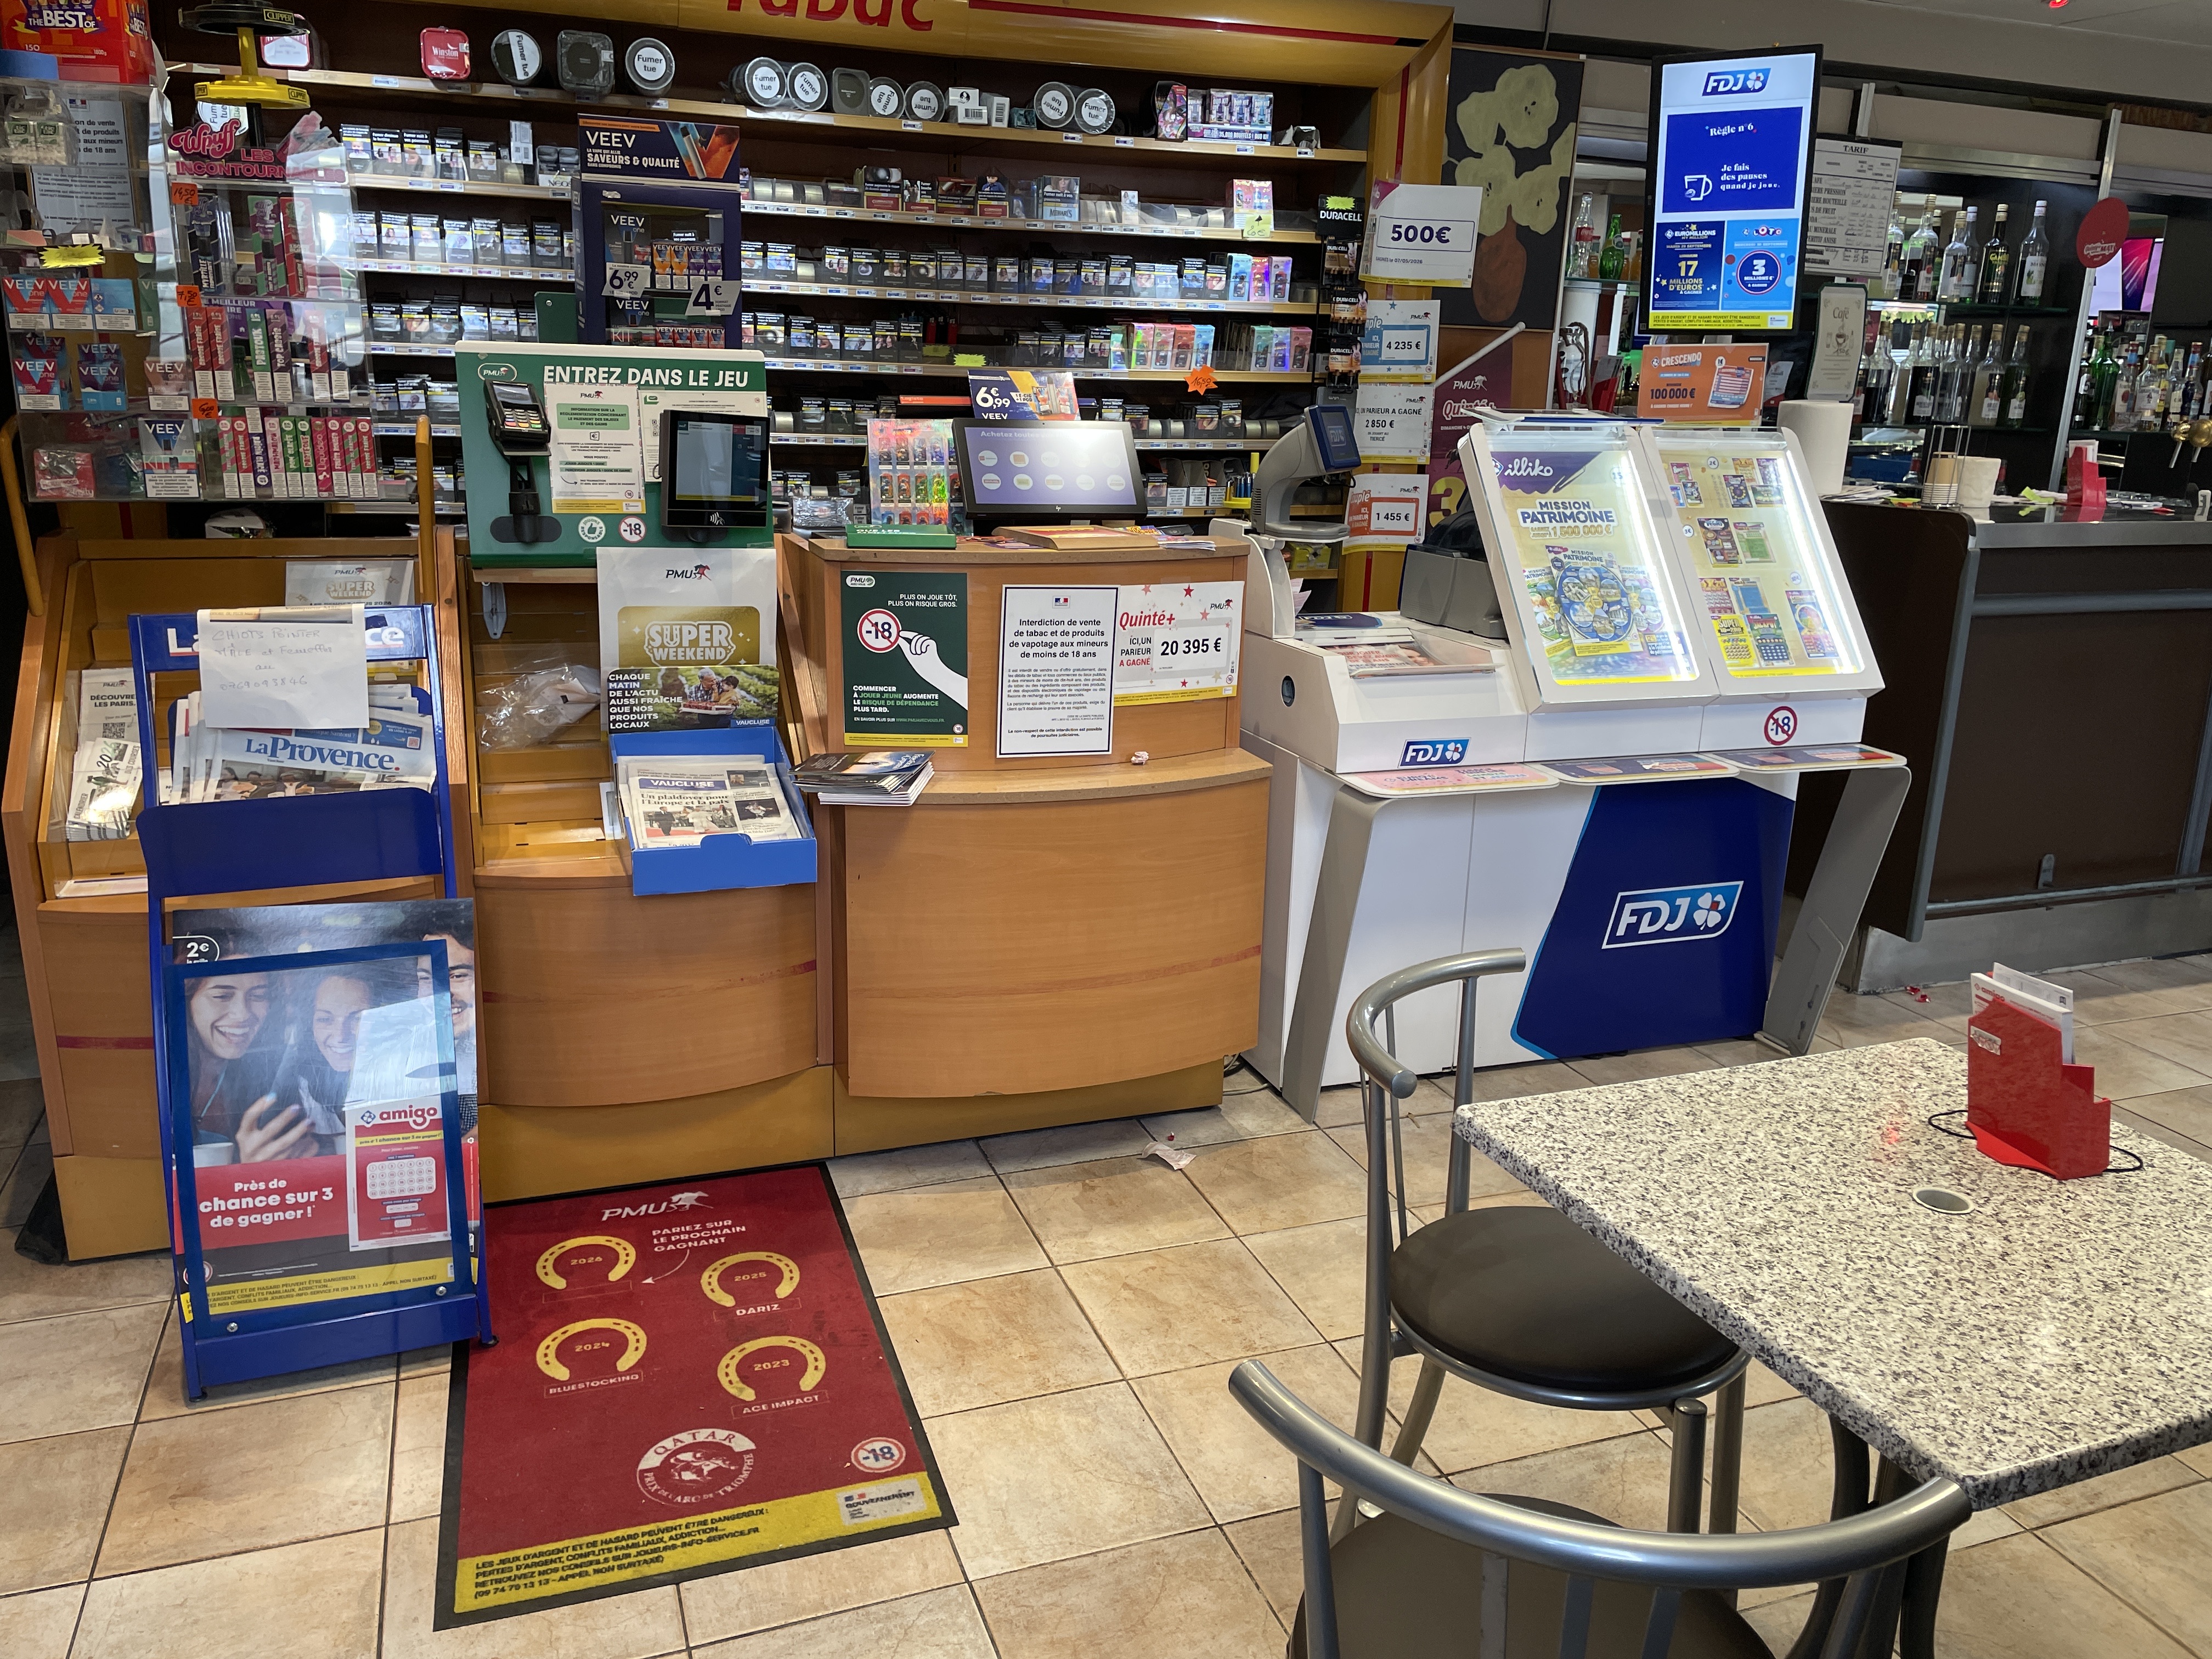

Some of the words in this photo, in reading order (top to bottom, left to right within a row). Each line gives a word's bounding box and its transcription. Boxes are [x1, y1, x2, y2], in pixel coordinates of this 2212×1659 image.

[42, 10, 86, 27] BEST
[267, 13, 292, 22] CLIPPER
[432, 45, 459, 57] Winston
[637, 55, 663, 64] Fumer
[1706, 74, 1745, 92] FDJ
[1085, 103, 1106, 111] Fumer
[1710, 125, 1736, 137] Règle
[586, 131, 636, 148] VEEV
[1843, 145, 1869, 154] TARIF
[241, 149, 274, 163] LES
[587, 154, 630, 165] SAVEURS
[642, 157, 680, 168] QUALITÉ
[1734, 163, 1750, 171] fais
[1720, 173, 1736, 181] des
[1737, 173, 1768, 182] pauses
[1720, 182, 1747, 191] quand
[1824, 188, 1847, 196] PRESSION
[1822, 197, 1848, 206] BOUTEILLE
[1320, 210, 1362, 222] DURACELL
[1391, 224, 1452, 244] 500€
[1678, 261, 1699, 276] 17
[1752, 259, 1766, 276] 3
[1386, 341, 1392, 350] 4
[1395, 341, 1413, 350] 235
[1415, 341, 1421, 350] €
[1661, 352, 1702, 368] CRESCENDO
[79, 367, 118, 376] VEEV
[543, 365, 622, 385] ENTREZ
[627, 367, 682, 386] DANS
[689, 369, 709, 386] LE
[714, 370, 749, 387] JEU
[1650, 388, 1668, 399] 100
[1669, 388, 1688, 399] 000
[1689, 388, 1696, 398] €
[1398, 407, 1422, 415] GAGNÉ
[1365, 420, 1370, 428] 2
[1371, 420, 1386, 428] 850
[1389, 420, 1395, 428] €
[1504, 456, 1554, 477] illiko
[1538, 501, 1591, 511] MISSION
[1376, 512, 1380, 521] 1
[1384, 512, 1402, 521] 455
[1404, 513, 1410, 521] €
[1520, 510, 1615, 524] PATRIMOINE
[1563, 554, 1604, 563] PATRIMOINE
[330, 590, 373, 598] WEEKEND
[1119, 610, 1176, 631] Quinté+
[1719, 618, 1741, 628] SUPER
[650, 624, 729, 647] SUPER
[1071, 629, 1105, 638] produits
[1021, 640, 1058, 649] vapotage
[1160, 640, 1178, 656] 20
[1182, 638, 1210, 654] 395
[1213, 637, 1222, 652] €
[653, 647, 726, 661] WEEKEND
[1120, 647, 1151, 656] PARIEUR
[1126, 656, 1150, 667] GAGNÉ
[640, 695, 683, 704] FRAÎCHE
[896, 698, 939, 707] DÉPENDANCE
[1770, 716, 1791, 736] -18
[245, 738, 268, 755] La
[1406, 744, 1444, 762] FDJ
[651, 780, 715, 788] VAUCLUSE
[1616, 897, 1691, 936] FDJ
[379, 1104, 438, 1126] amigo
[234, 1180, 266, 1192] Près
[268, 1178, 287, 1189] de
[199, 1194, 281, 1213] chance
[285, 1190, 319, 1205] sur
[321, 1187, 334, 1200] 3
[210, 1215, 234, 1228] de
[238, 1209, 304, 1227] gagner
[652, 1222, 703, 1236] PARIEZ
[706, 1220, 732, 1229] SUR
[653, 1236, 668, 1245] LE
[671, 1225, 746, 1243] PROCHAIN
[654, 1237, 727, 1252] GAGNANT
[570, 1256, 603, 1266] 2026
[733, 1271, 767, 1282] 2025
[736, 1304, 780, 1316] DARIZ
[574, 1342, 610, 1352] 2024
[753, 1359, 790, 1372] 2023
[549, 1373, 640, 1395] BLUESTOCKING
[742, 1402, 769, 1414] ACE
[771, 1394, 820, 1409] IMPACT
[653, 1430, 736, 1457] QATAR
[845, 1490, 916, 1509] GOUVERNEMENT
